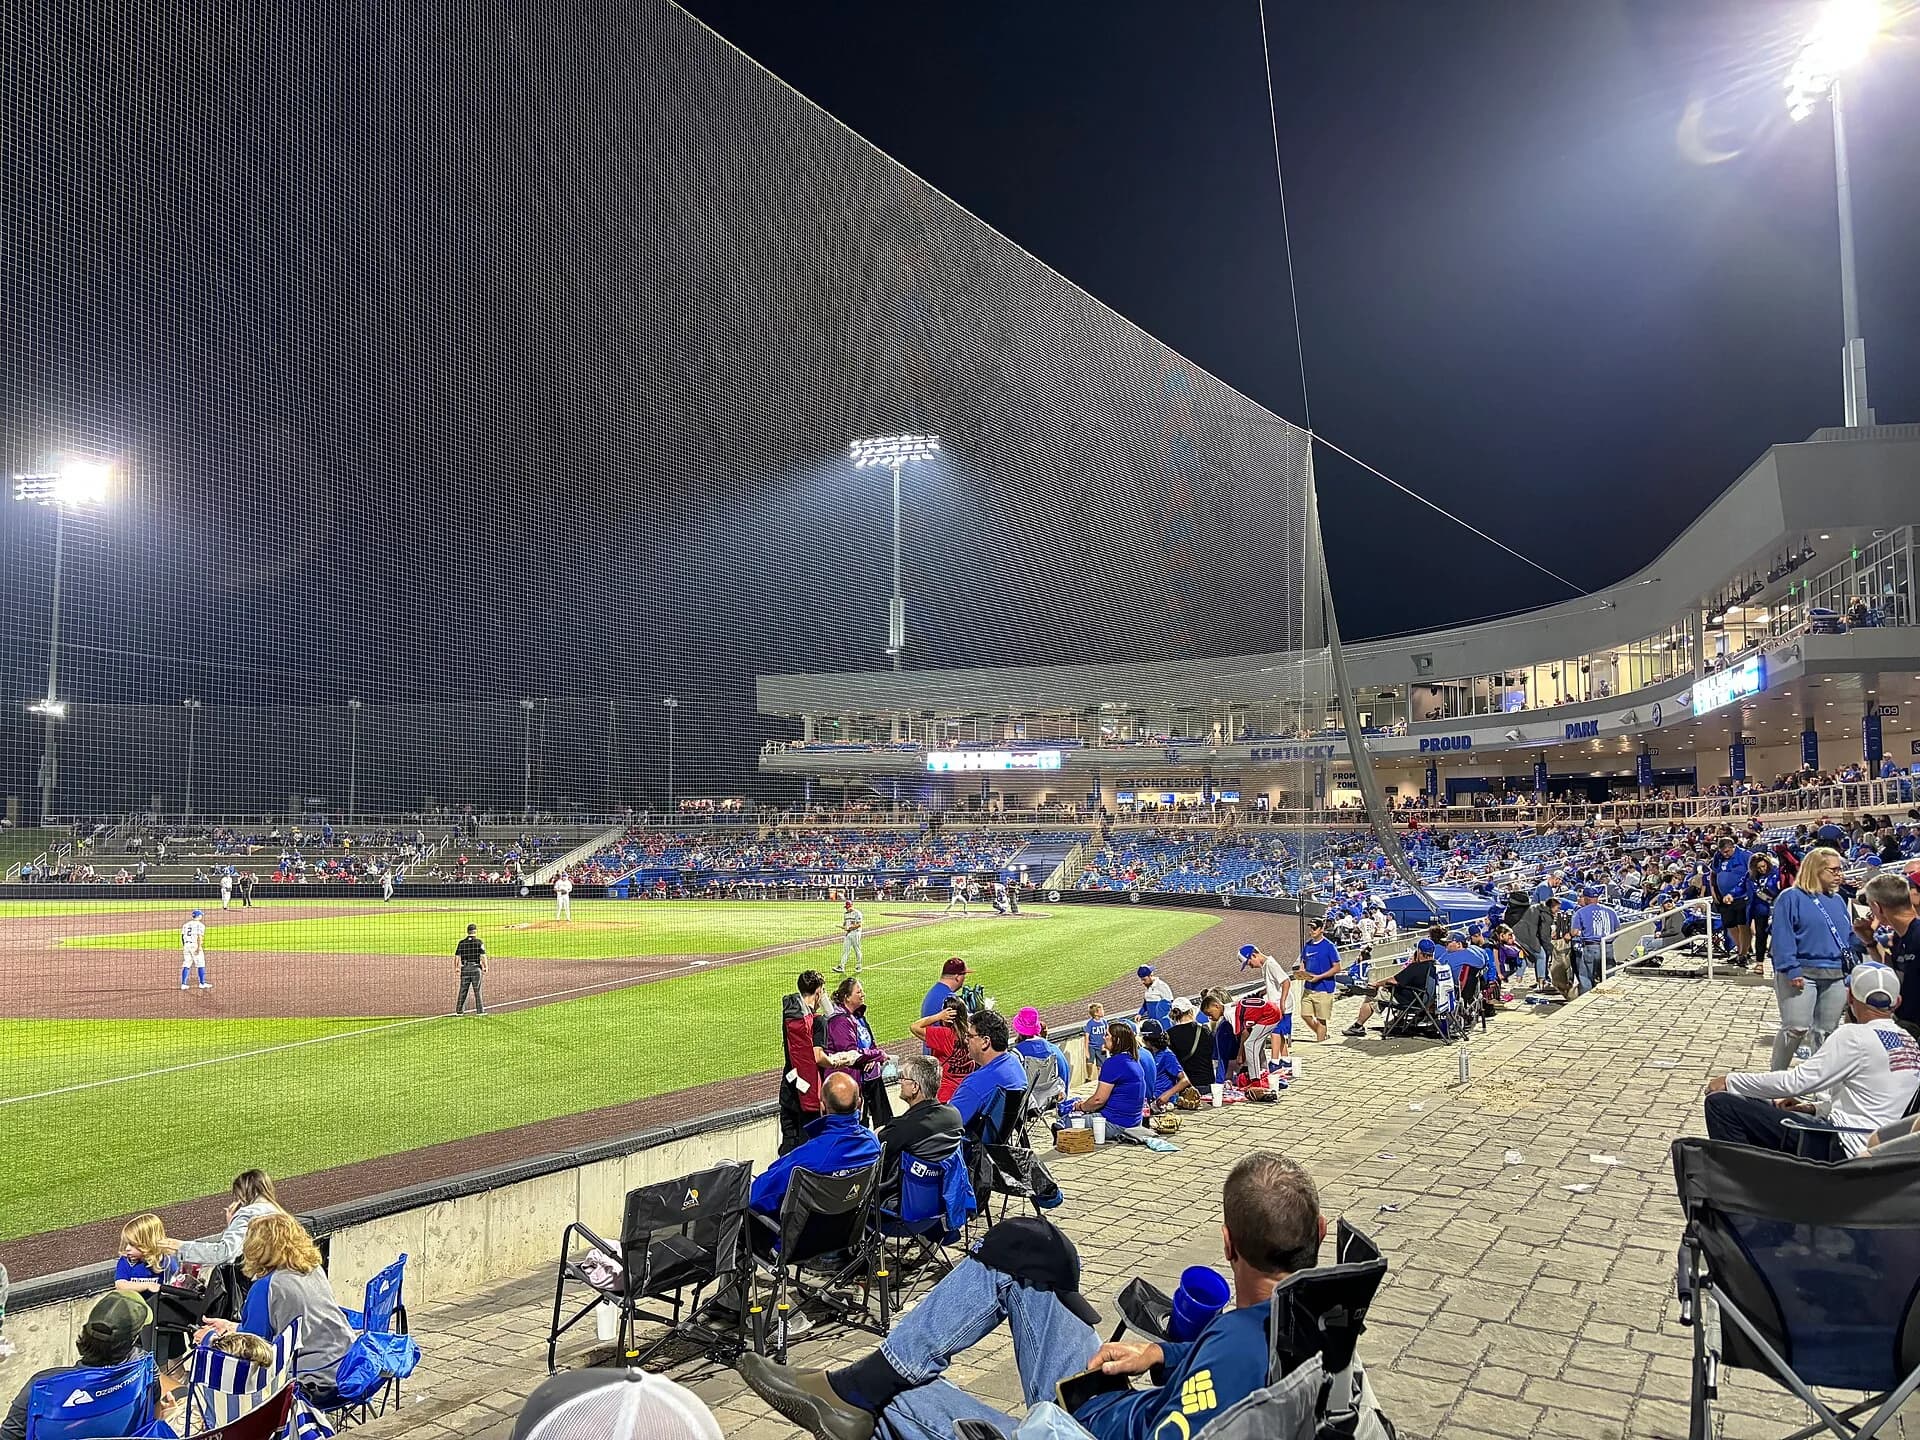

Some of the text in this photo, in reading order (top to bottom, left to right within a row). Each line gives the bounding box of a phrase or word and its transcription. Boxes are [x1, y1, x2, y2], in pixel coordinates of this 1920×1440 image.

[1880, 706, 1898, 716] 109
[1565, 719, 1600, 739] PARK
[1420, 735, 1472, 752] PROUD
[1742, 737, 1756, 745] 108
[1250, 745, 1335, 760] KENTUCKY
[1135, 777, 1220, 788] CONCESSIOS
[1337, 781, 1358, 789] ZONE
[808, 874, 874, 887] KENTUCKY
[186, 927, 193, 937] 2
[95, 1382, 123, 1397] OZARK
